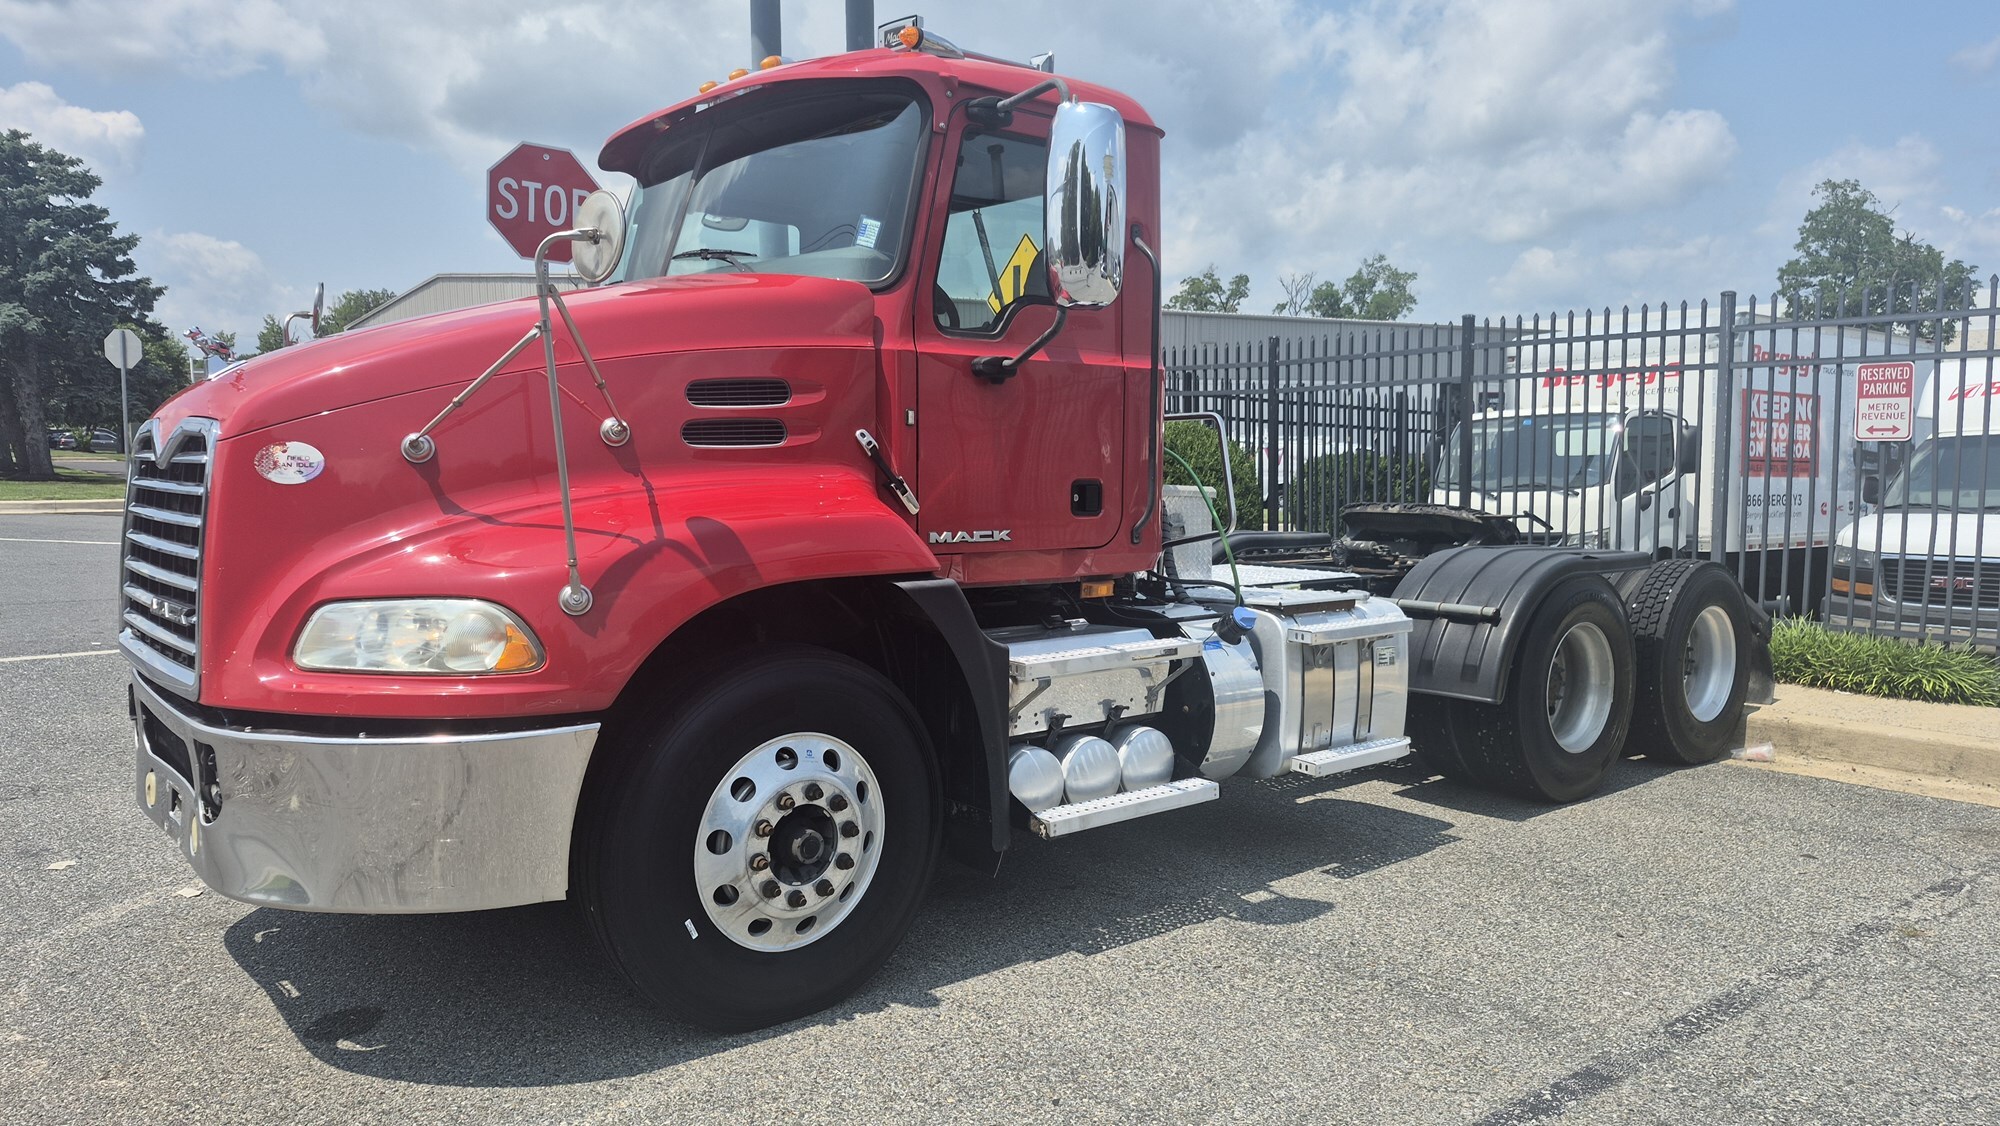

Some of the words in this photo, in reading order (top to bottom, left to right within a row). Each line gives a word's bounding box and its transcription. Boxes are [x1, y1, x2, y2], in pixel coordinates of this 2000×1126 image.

[1861, 367, 1910, 381] RESERVED
[1863, 382, 1907, 396] PARKING
[1751, 393, 1813, 421] KEEPN
[1868, 403, 1900, 411] METRO
[1861, 412, 1906, 420] REVENUE
[1749, 440, 1764, 457] ON
[1770, 441, 1787, 458] HE
[929, 530, 1012, 543] MACK
